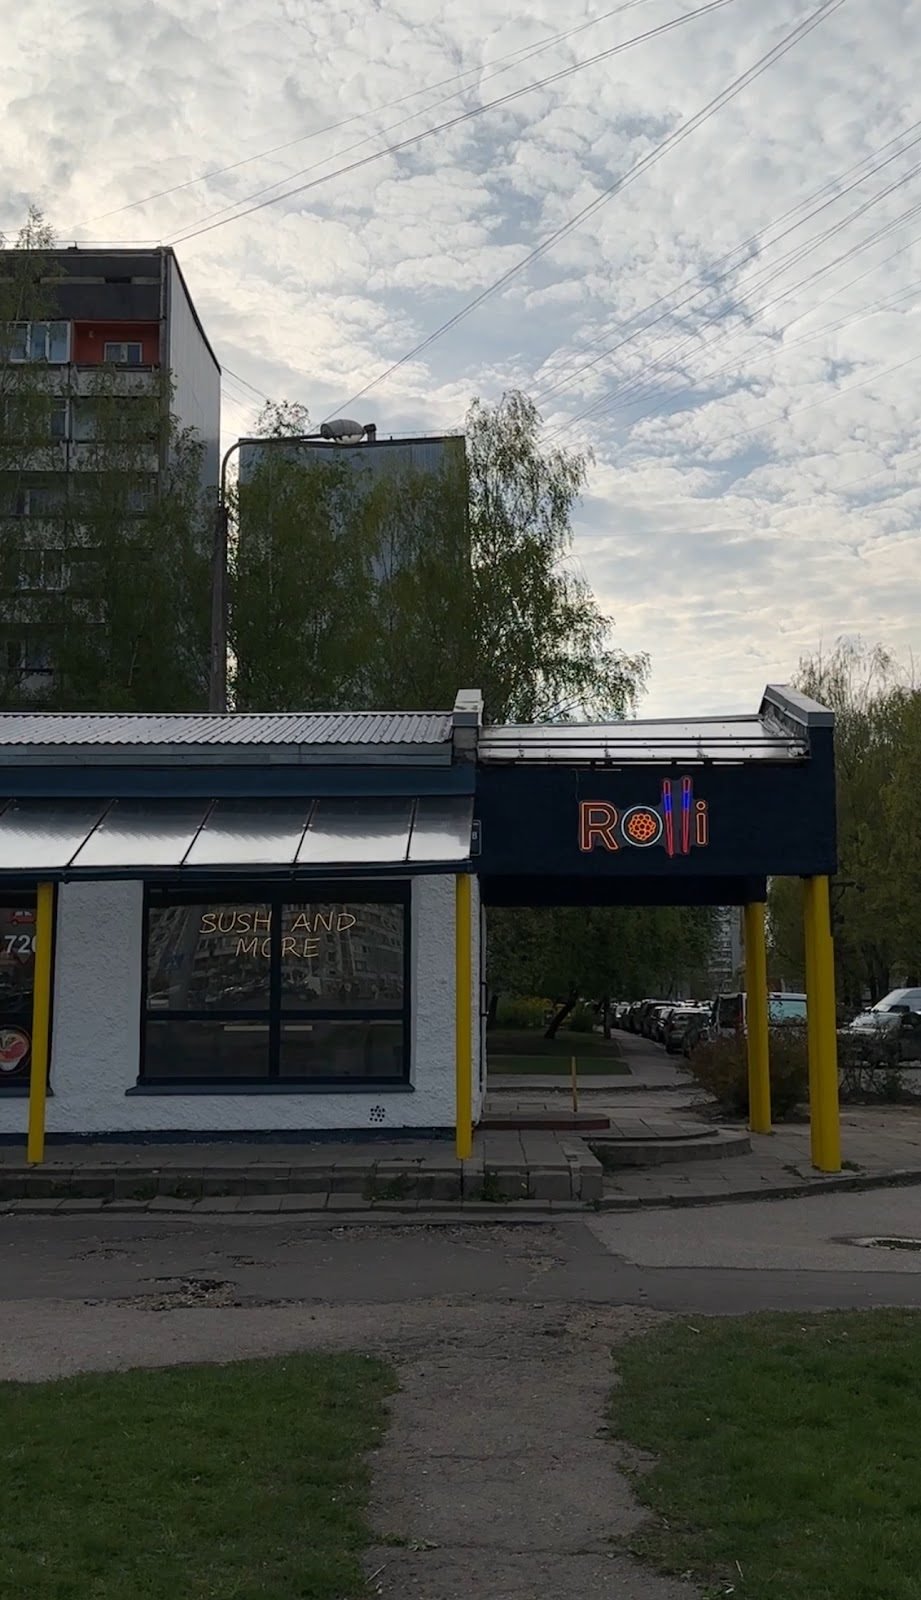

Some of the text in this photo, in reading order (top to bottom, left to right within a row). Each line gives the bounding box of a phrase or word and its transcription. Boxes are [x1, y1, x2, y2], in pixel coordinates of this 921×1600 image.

[579, 775, 708, 858] Rolli
[199, 911, 357, 934] SUSH AND
